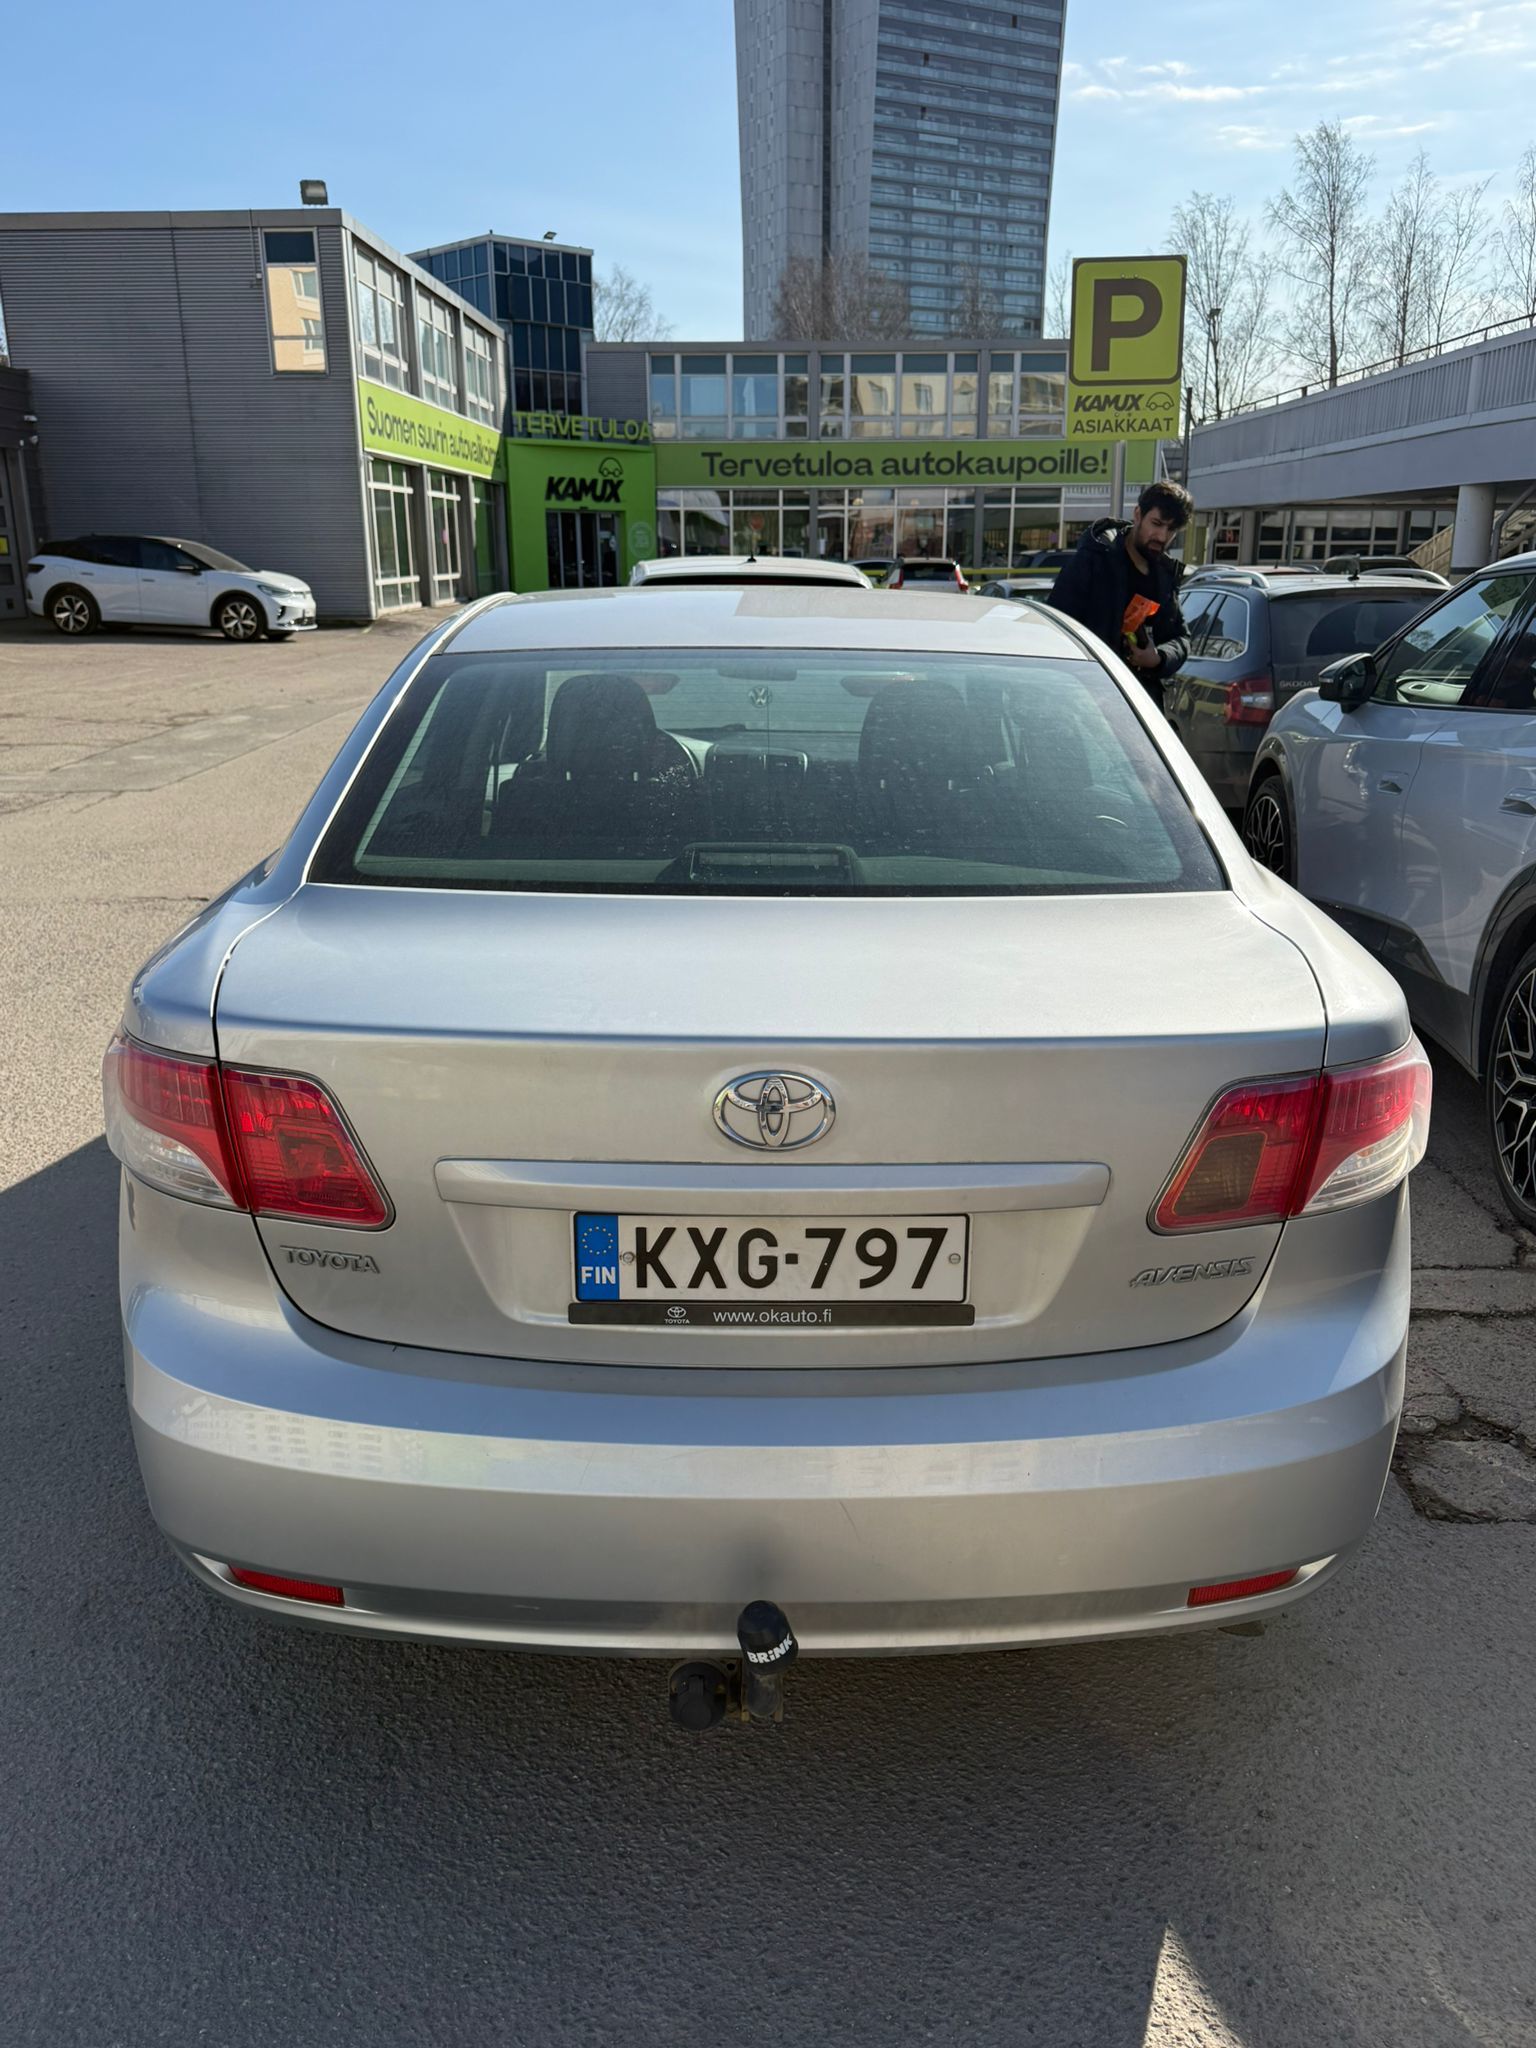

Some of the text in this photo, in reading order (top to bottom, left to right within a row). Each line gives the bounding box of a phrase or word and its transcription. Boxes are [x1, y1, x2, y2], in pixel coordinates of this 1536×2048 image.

[1091, 278, 1163, 372] P
[1073, 394, 1144, 412] KAMUX
[367, 396, 417, 447] Suomen
[512, 411, 652, 440] TERVETULOA
[1072, 418, 1174, 434] ASIAKKAAT
[701, 449, 1109, 481] Tervetuloa autokaupoille!
[545, 476, 624, 503] KAMUX
[280, 1245, 380, 1274] TOYOTA
[634, 1226, 949, 1290] KXG-797
[1129, 1256, 1256, 1287] AVENSIS
[581, 1266, 616, 1285] FIN
[713, 1309, 832, 1324] www.okauto.fi
